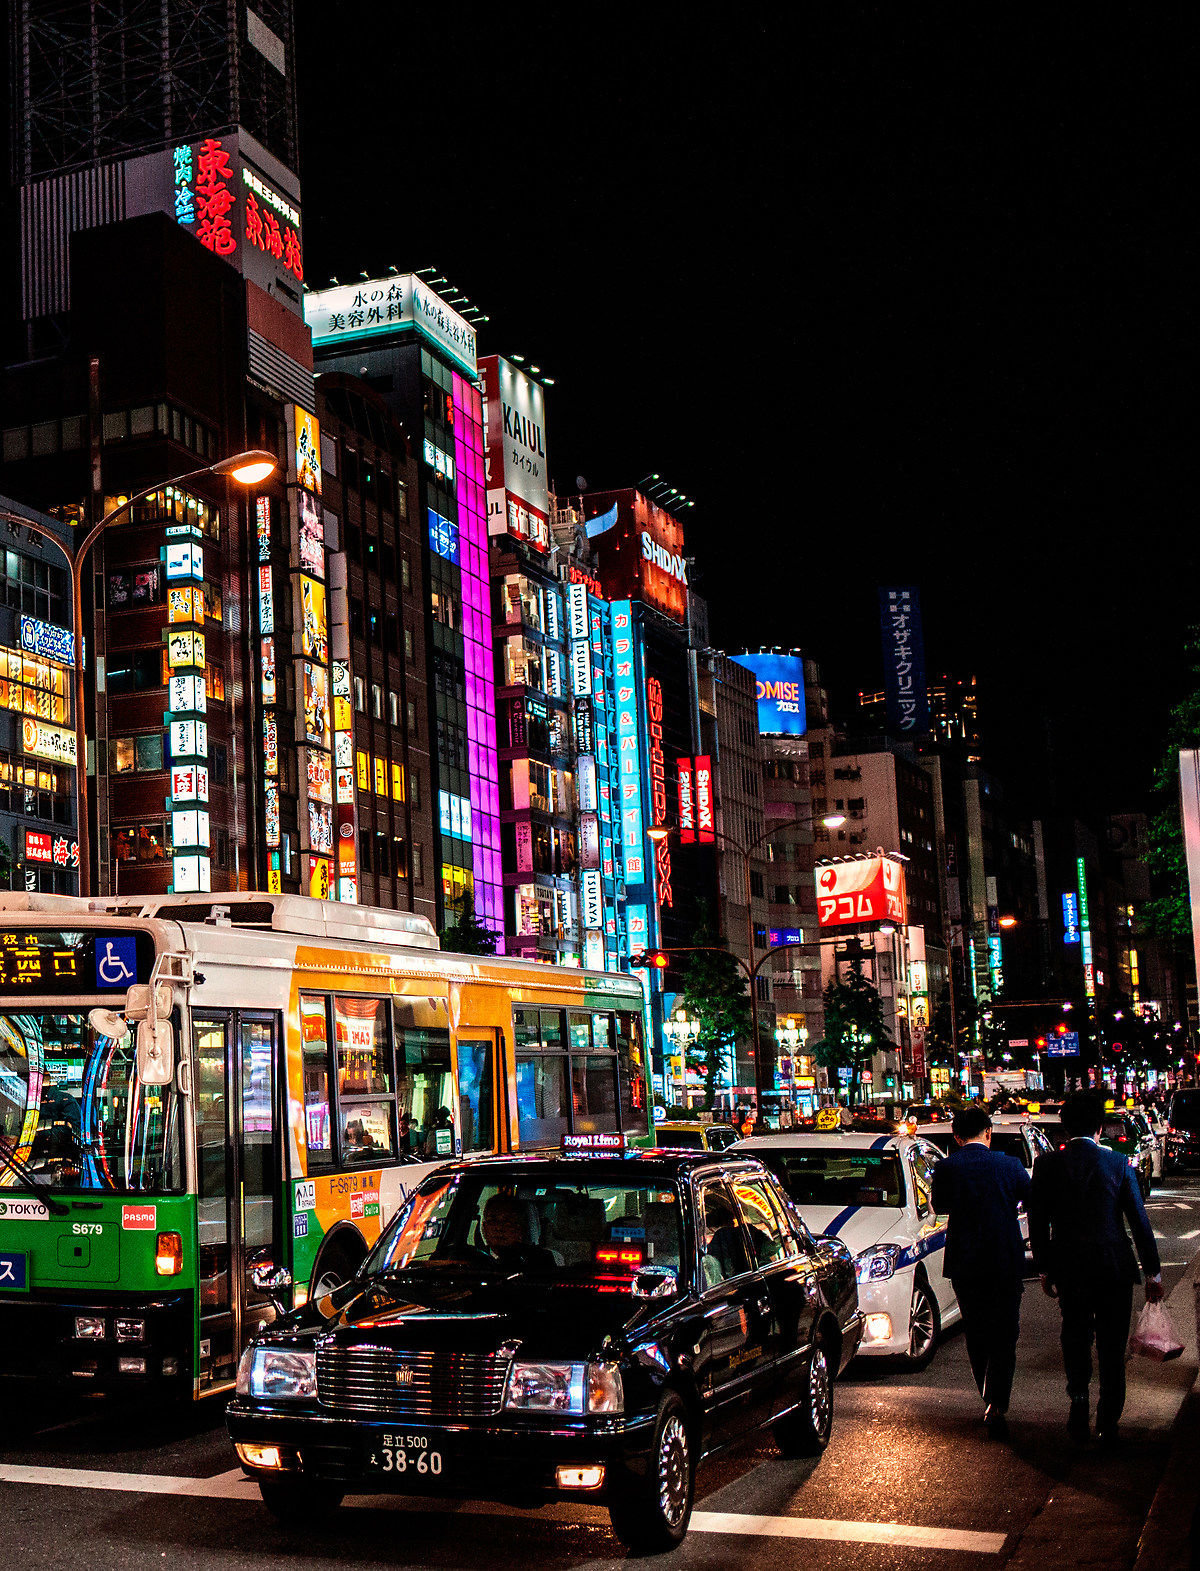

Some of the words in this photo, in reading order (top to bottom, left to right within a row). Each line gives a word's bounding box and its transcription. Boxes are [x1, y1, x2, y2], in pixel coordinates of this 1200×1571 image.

[195, 138, 237, 255] 東海苑
[245, 192, 303, 280] 東海苑
[351, 284, 403, 308] 水の森
[328, 302, 404, 333] 美容外科
[422, 298, 476, 357] 水の森美容外科
[503, 402, 545, 459] KAIUL
[512, 449, 539, 478] カイウル
[641, 531, 688, 586] SHIDAX
[572, 586, 584, 636] TSUTAYA
[576, 643, 587, 693] TSUTAYA
[892, 614, 916, 730] オザキクリニック
[756, 680, 799, 701] OMISE
[776, 701, 800, 713] プロミス
[614, 614, 642, 872] カラオケ&パーティー館
[697, 769, 711, 829] SHIDAX
[586, 874, 596, 924] TSUTAYA
[820, 899, 874, 923] アコム
[886, 892, 903, 918] アコム
[564, 1136, 595, 1148] Royal
[596, 1135, 621, 1146] Limo
[302, 1185, 315, 1197] 入口
[330, 1177, 358, 1192] F-S679
[364, 1193, 379, 1202] PASMO
[8, 1203, 47, 1217] TOKYO
[124, 1213, 154, 1222] PASMO
[365, 1205, 380, 1214] Suica
[72, 1223, 103, 1236] S679
[383, 1435, 404, 1447] 足立
[406, 1436, 428, 1449] 500
[382, 1449, 443, 1475] 38-60
